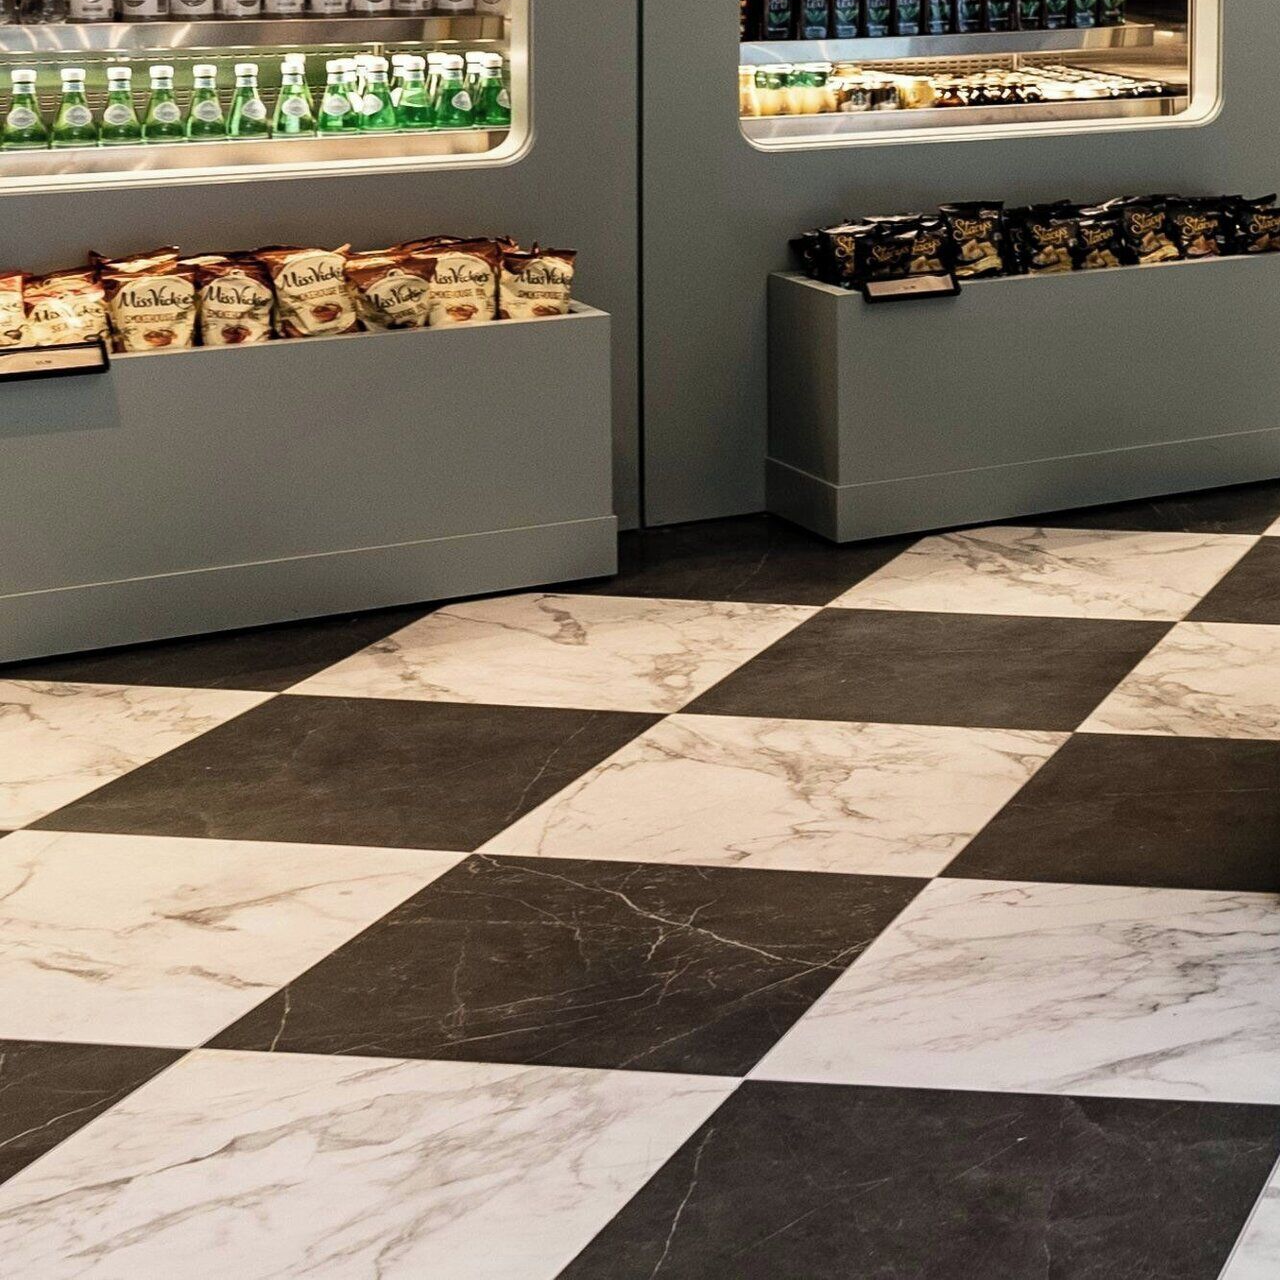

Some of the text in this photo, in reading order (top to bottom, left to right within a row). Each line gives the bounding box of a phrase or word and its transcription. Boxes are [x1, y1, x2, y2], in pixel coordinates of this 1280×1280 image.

[281, 271, 314, 290] Miss
[118, 291, 151, 308] Miss
[203, 286, 235, 303] Miss
